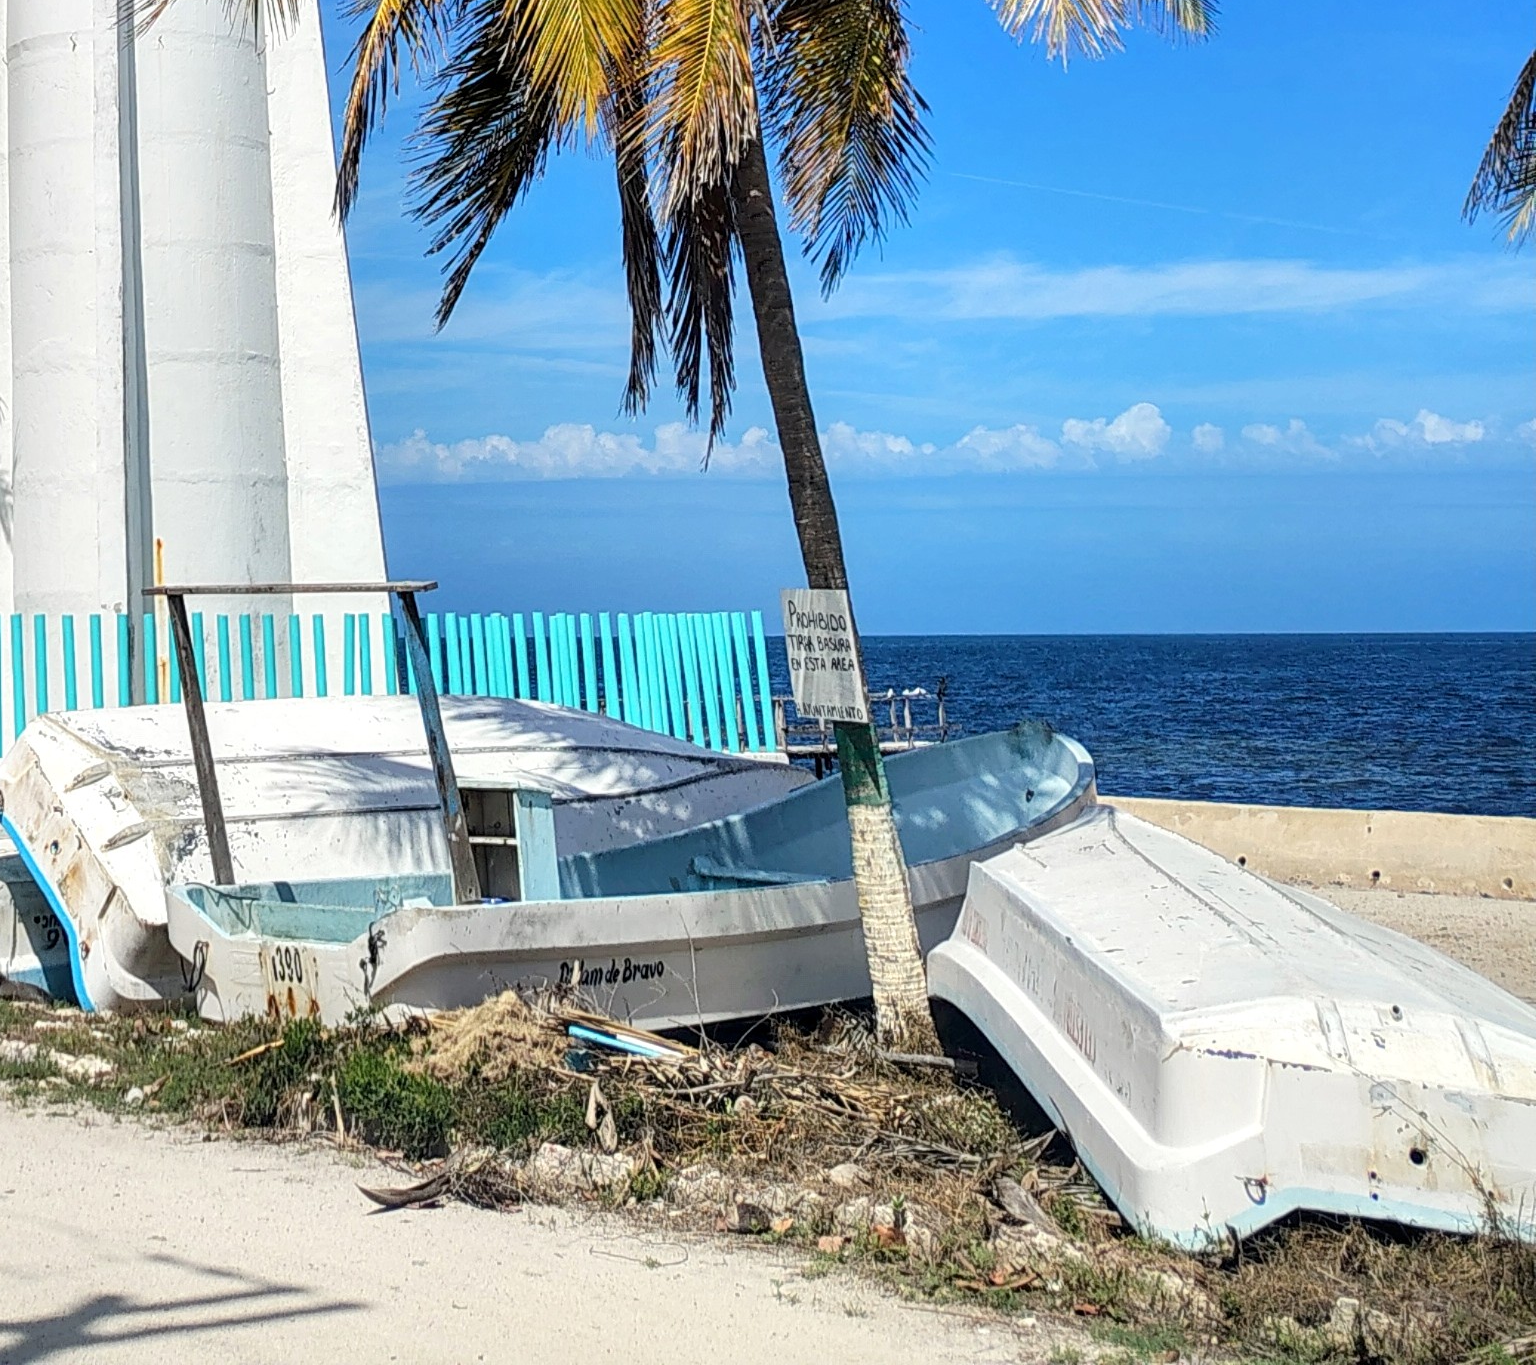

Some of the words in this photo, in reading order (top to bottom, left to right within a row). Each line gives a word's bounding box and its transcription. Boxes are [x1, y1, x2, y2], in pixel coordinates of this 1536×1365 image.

[788, 600, 847, 632] PROHIBIDO
[787, 633, 815, 653] TIRAR
[817, 635, 851, 653] BASURA
[791, 657, 802, 671] EN
[605, 959, 620, 984] de
[622, 957, 664, 984] Bravo
